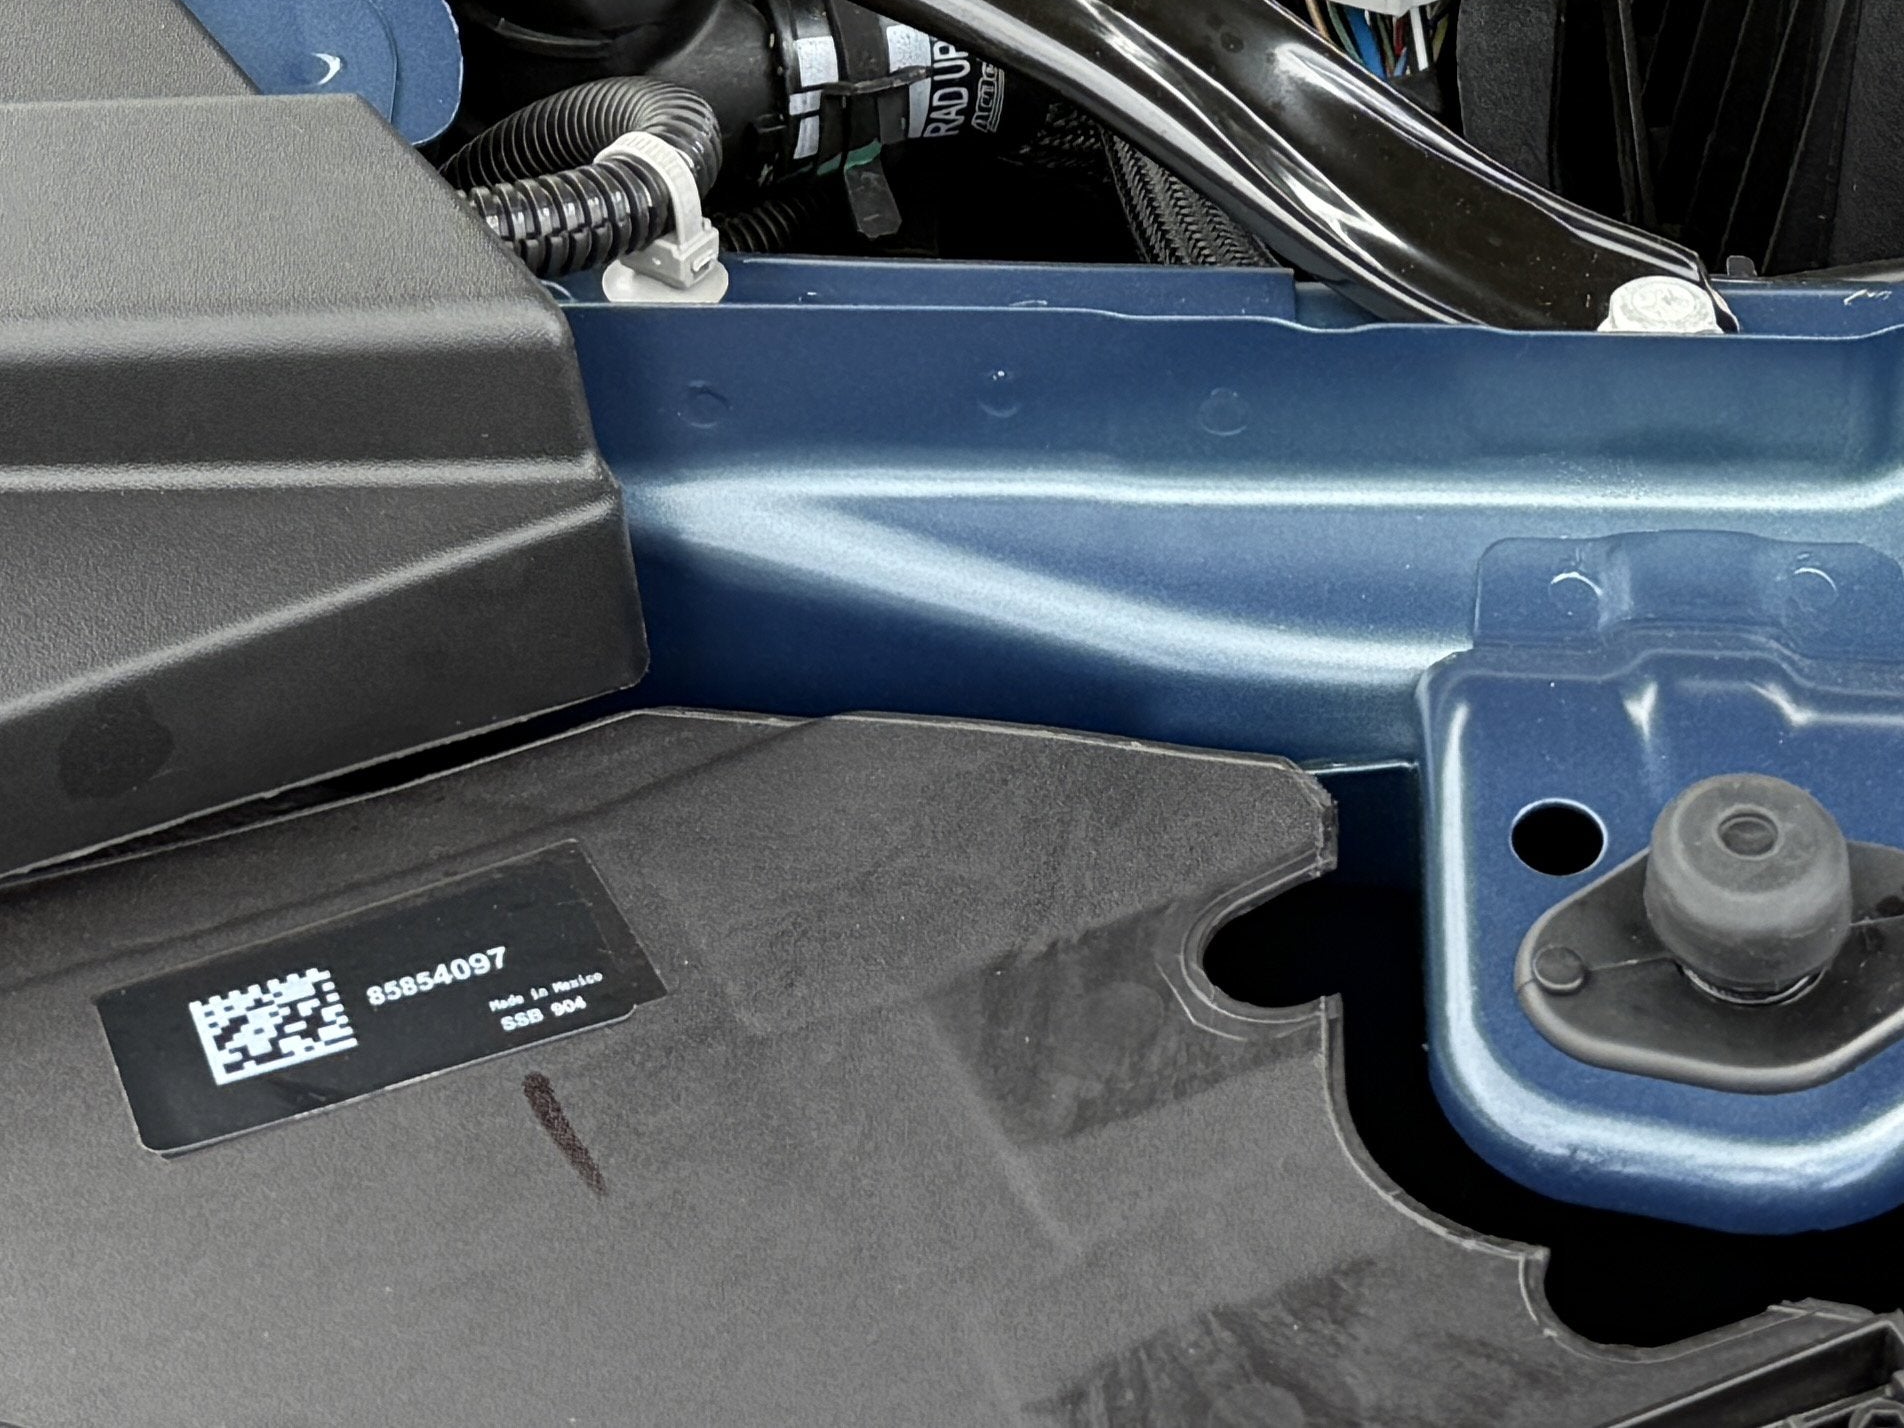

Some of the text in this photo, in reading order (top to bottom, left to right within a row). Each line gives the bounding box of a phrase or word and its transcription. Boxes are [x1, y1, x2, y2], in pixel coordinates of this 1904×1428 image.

[923, 39, 973, 138] RAD UP
[365, 945, 506, 1007] 85854097
[488, 972, 604, 1012] Made in Mexico
[499, 995, 588, 1032] SSB 904
